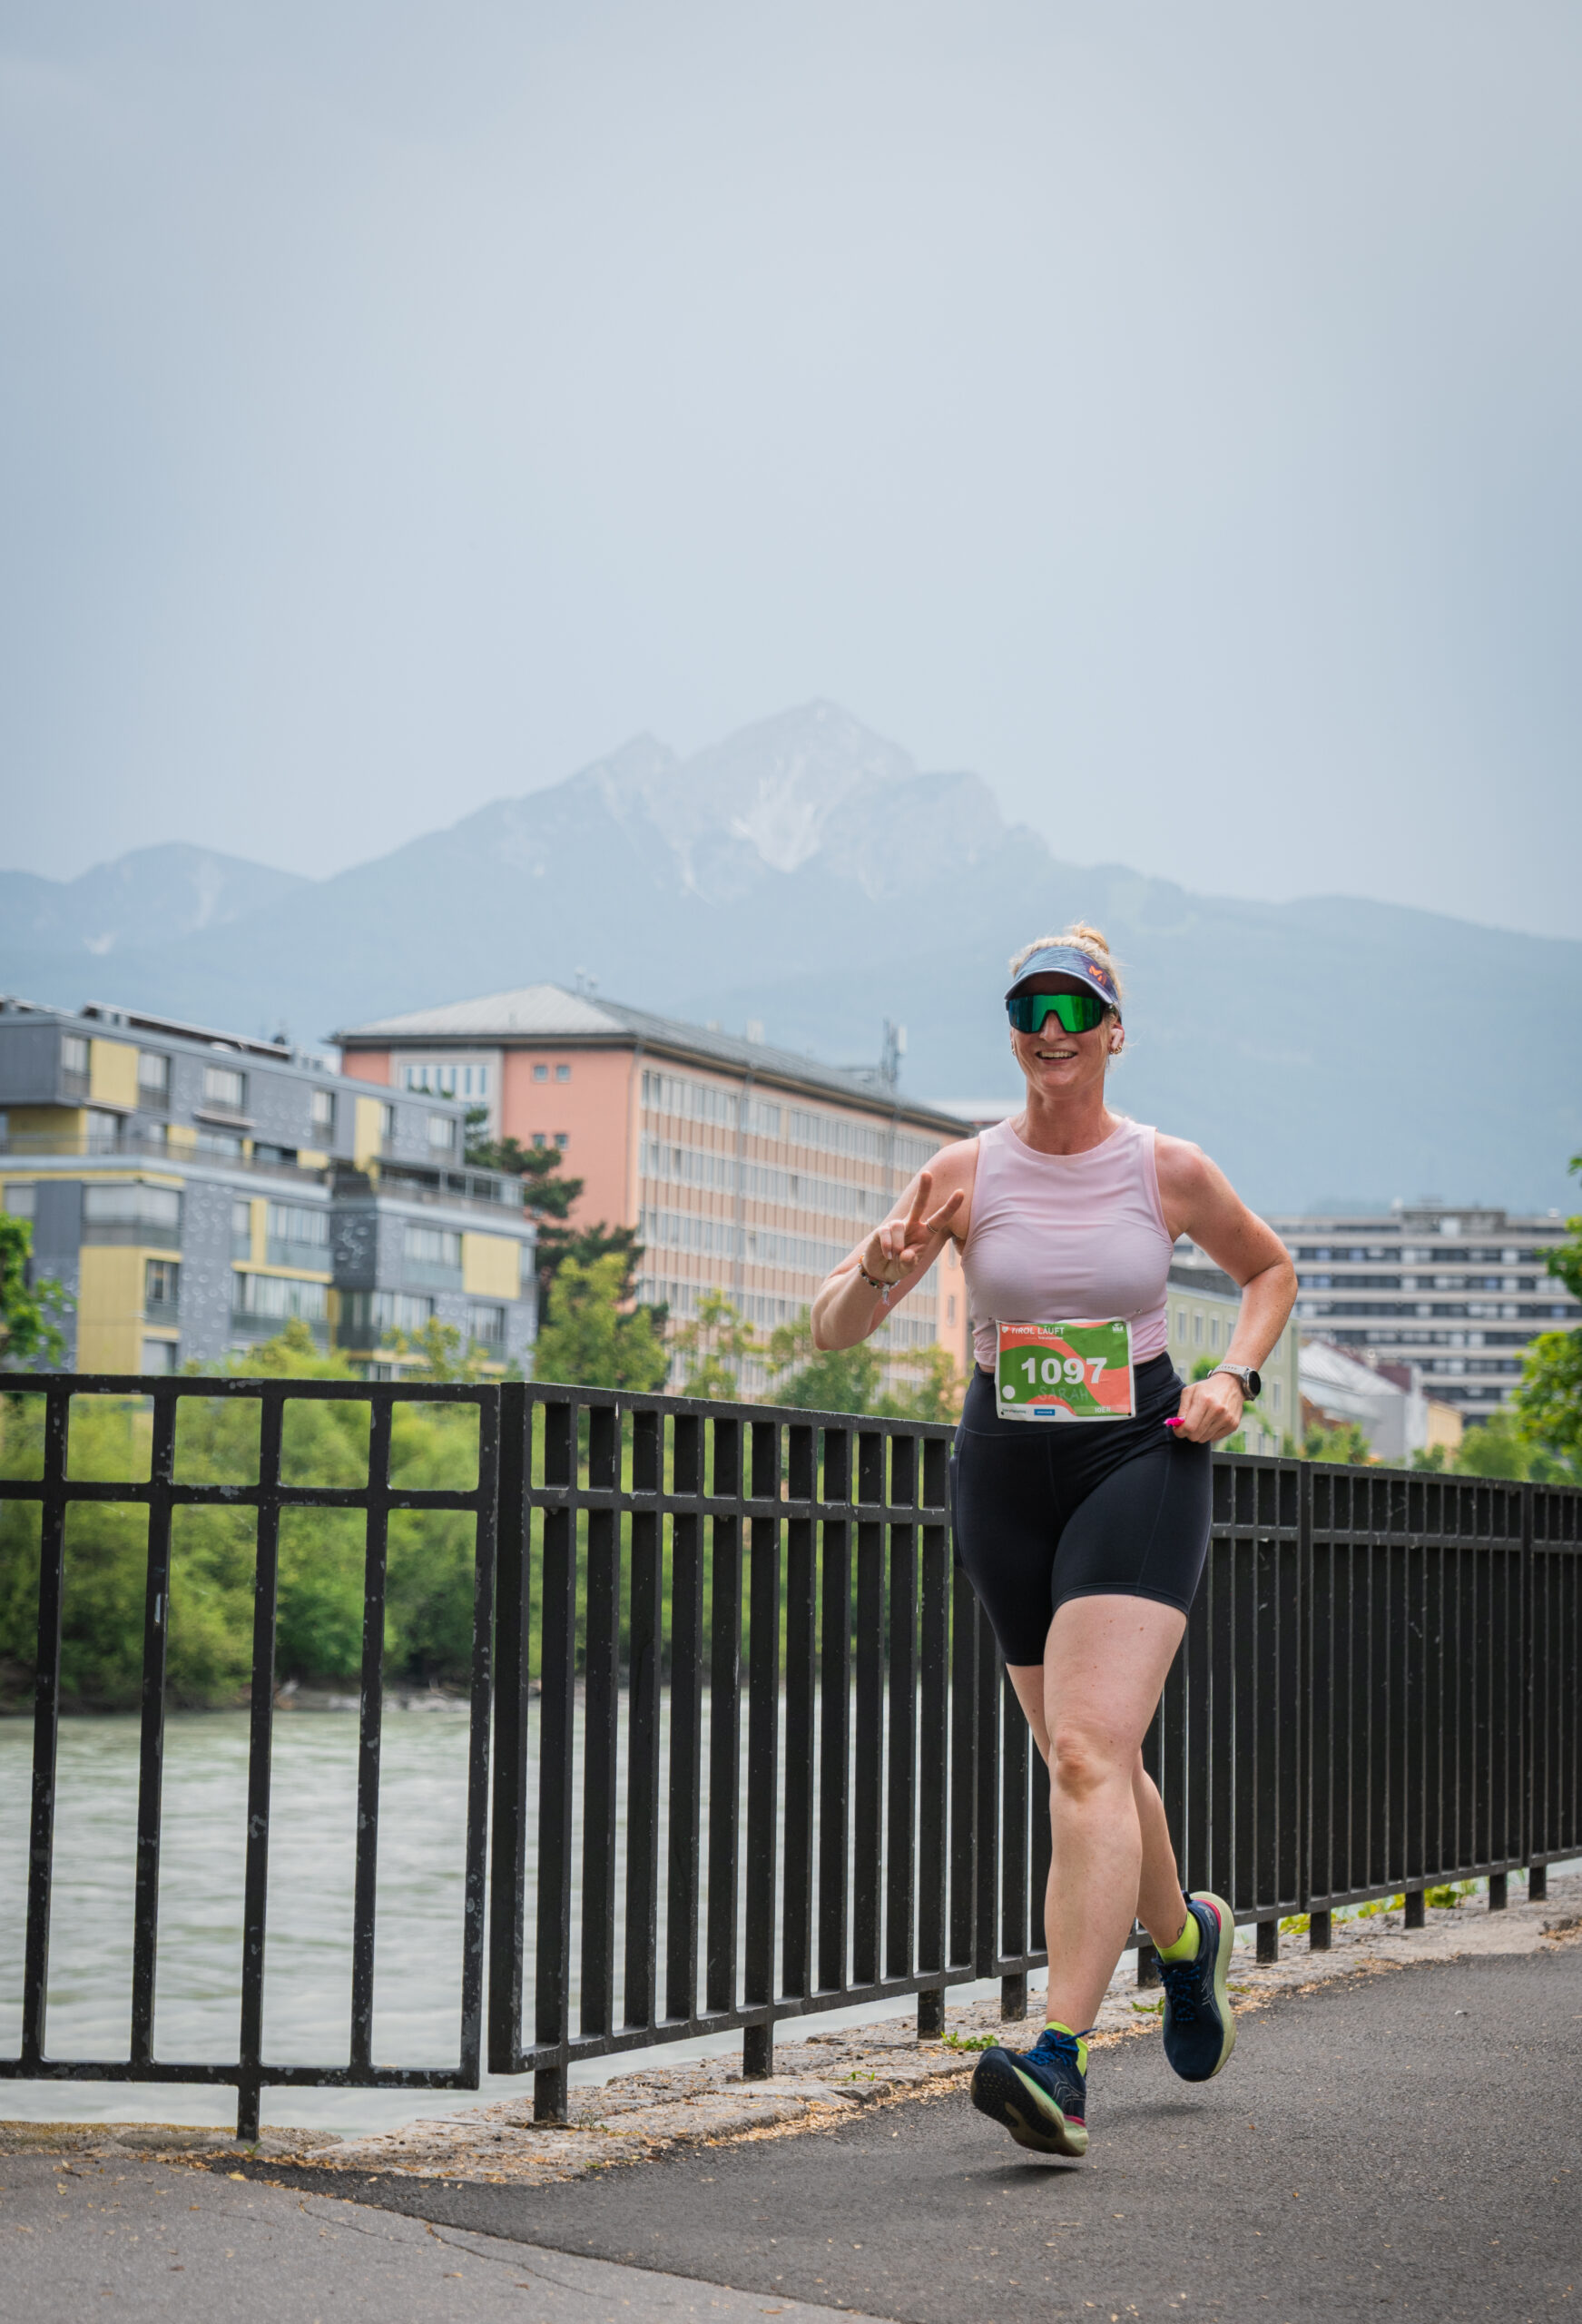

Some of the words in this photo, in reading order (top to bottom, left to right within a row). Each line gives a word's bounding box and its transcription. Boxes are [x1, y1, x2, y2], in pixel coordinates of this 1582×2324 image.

[1011, 1326, 1035, 1335] TIROL
[1021, 1357, 1107, 1384] 1097
[1038, 1385, 1089, 1401] SARAH
